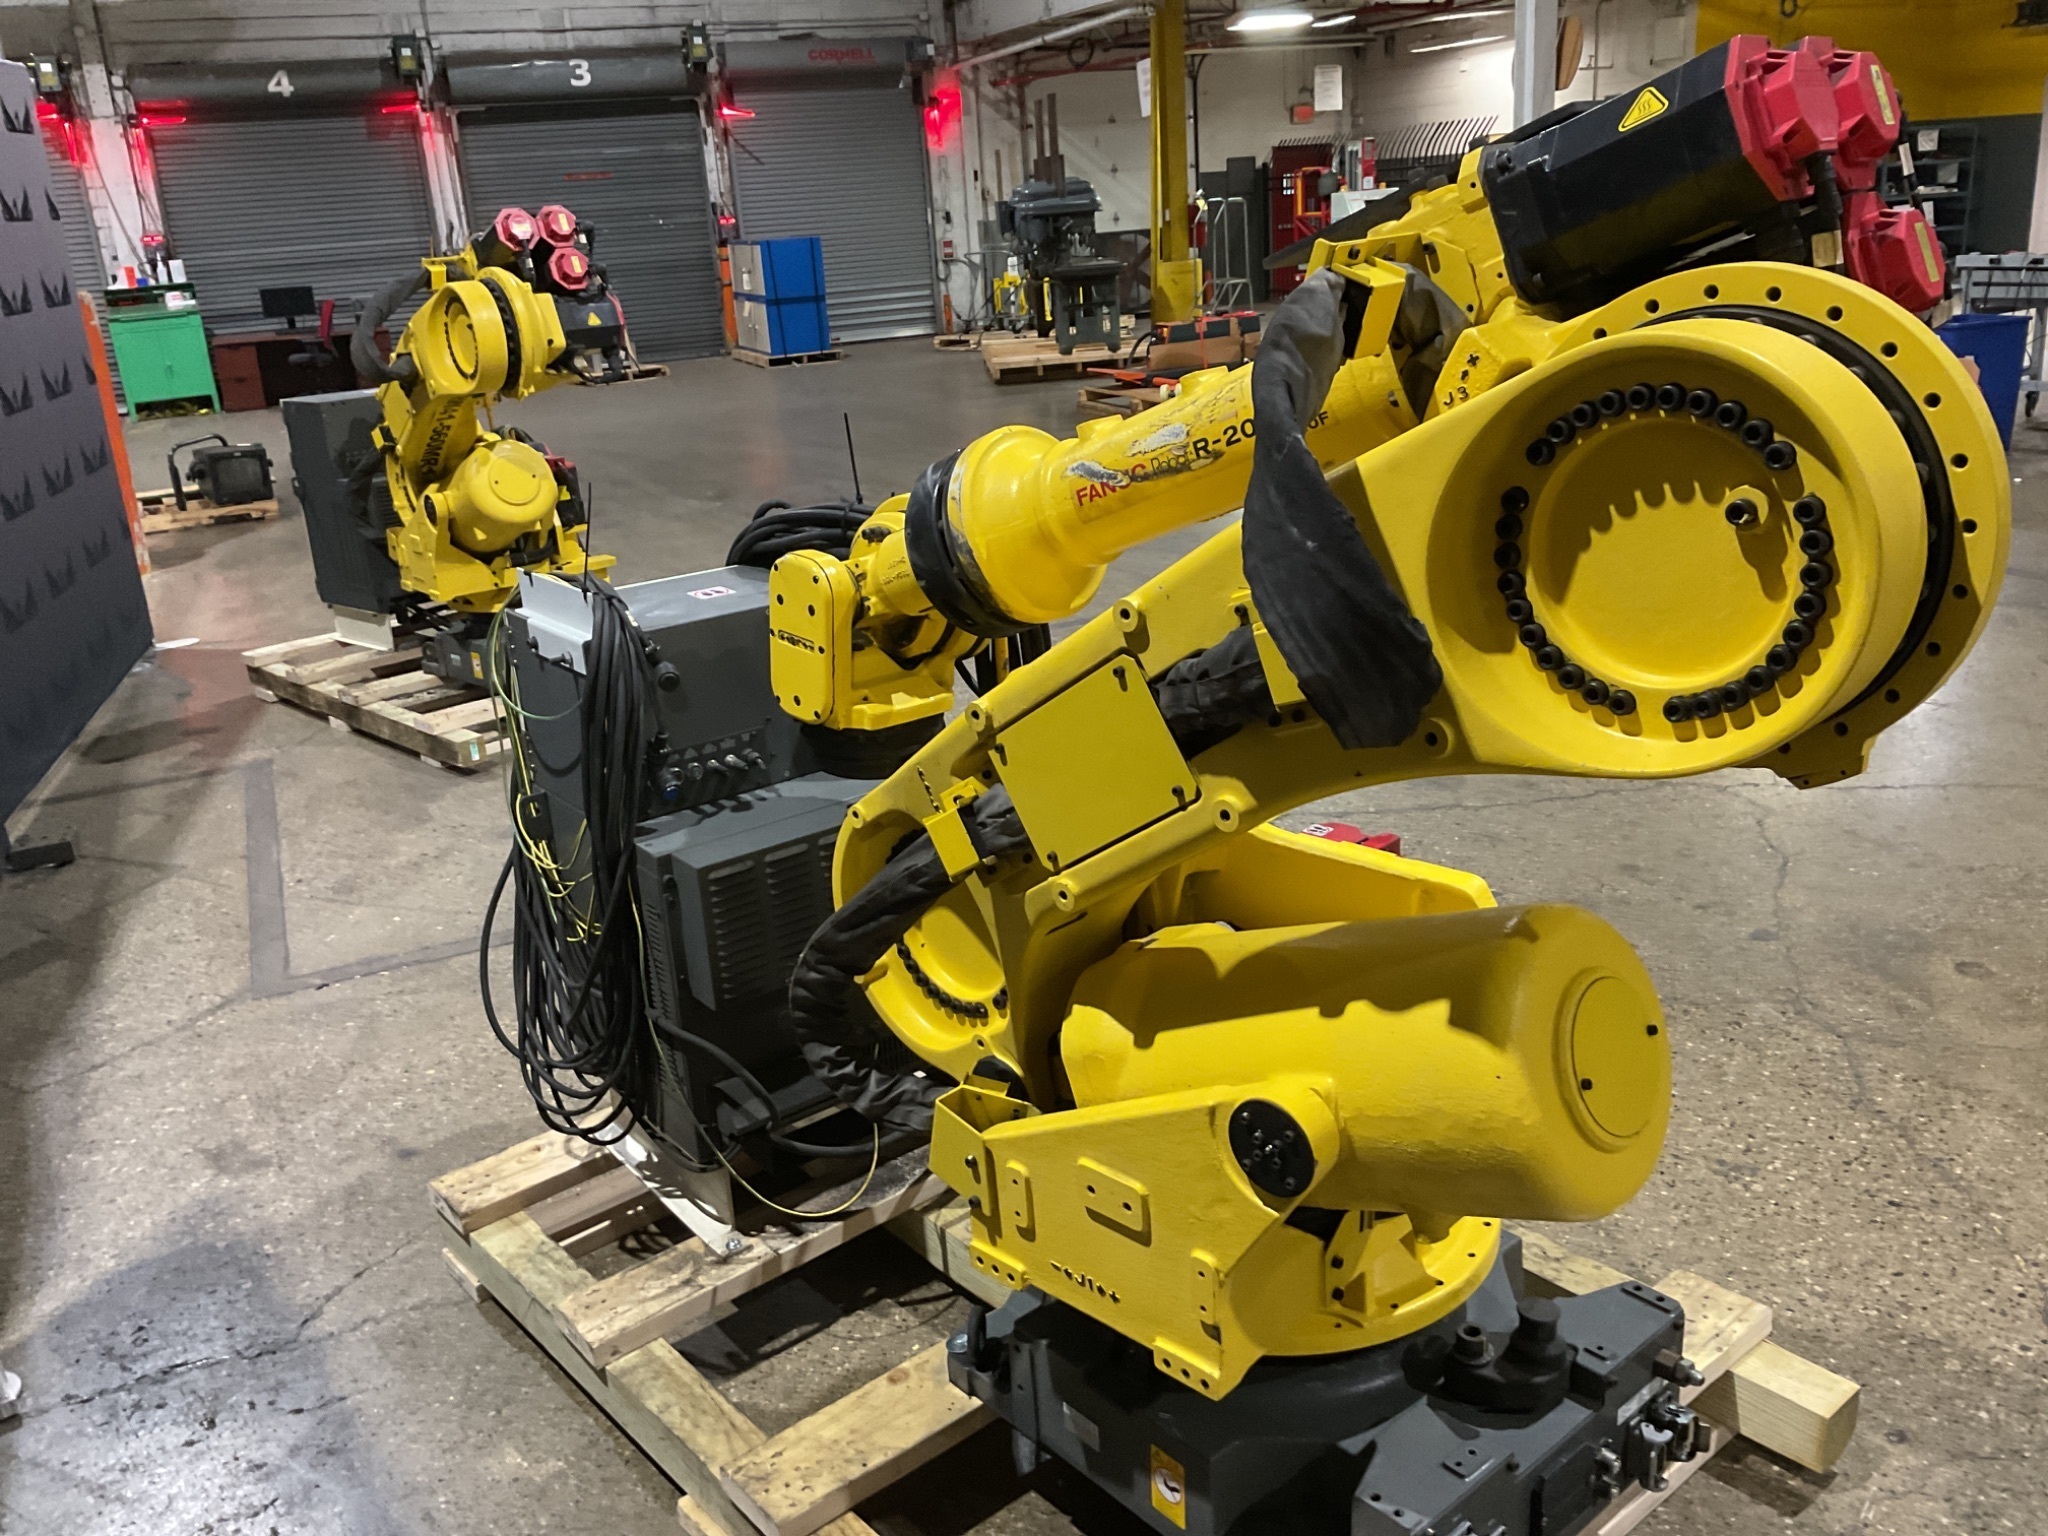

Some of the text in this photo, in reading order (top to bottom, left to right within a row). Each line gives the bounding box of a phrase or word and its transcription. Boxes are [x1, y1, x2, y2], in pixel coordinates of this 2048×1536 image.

[267, 70, 294, 97] 4
[569, 59, 591, 86] 3
[1443, 386, 1469, 406] J3
[1193, 419, 1256, 459] R-20
